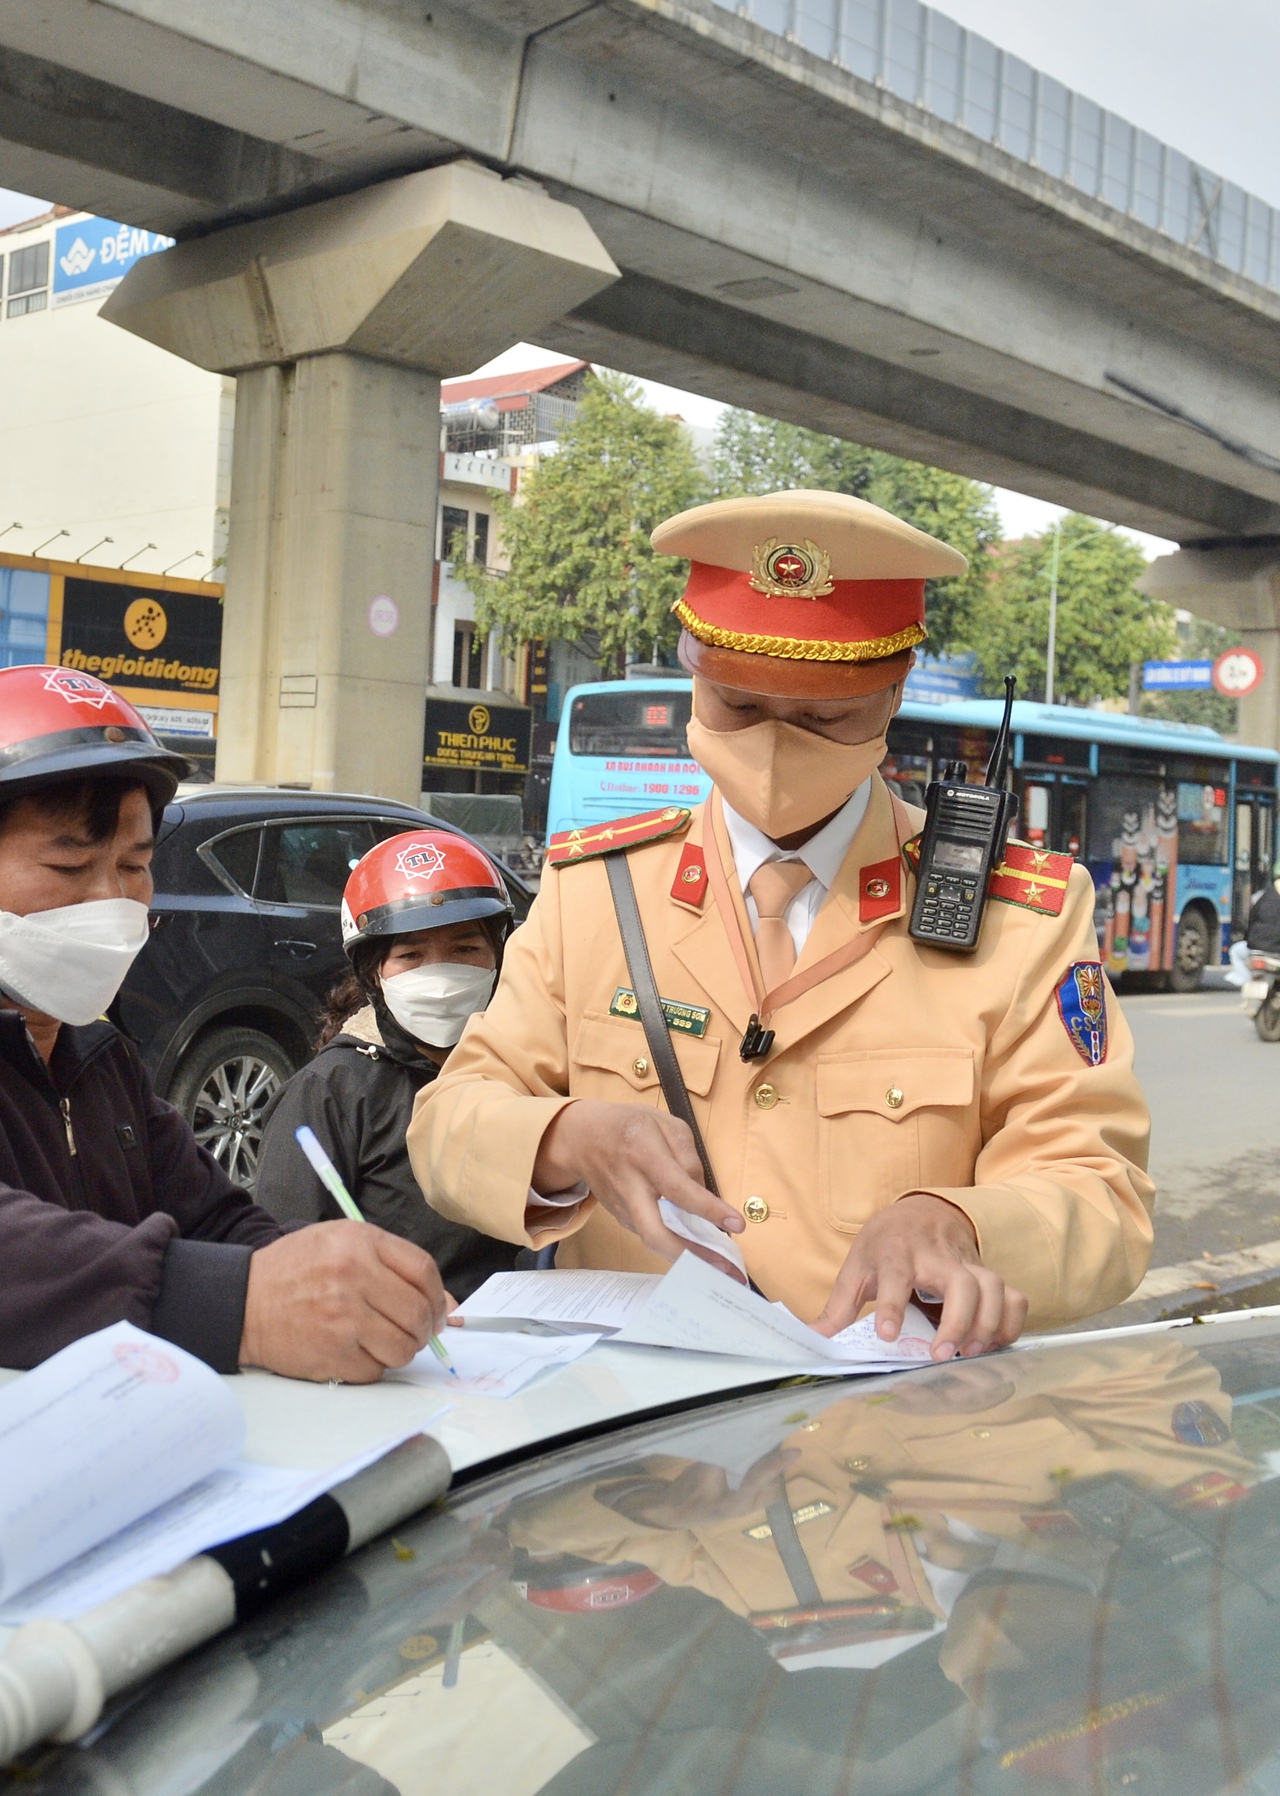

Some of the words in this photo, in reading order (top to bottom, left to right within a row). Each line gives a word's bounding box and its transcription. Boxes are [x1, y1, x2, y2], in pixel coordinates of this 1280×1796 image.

[99, 223, 149, 266] ĐỆM
[62, 648, 219, 689] thegioididong
[59, 678, 102, 692] TL
[618, 761, 633, 772] BUS
[635, 762, 666, 772] NHANH
[643, 783, 669, 794] 1900
[674, 784, 700, 795] 1296
[956, 791, 990, 801] MOTOROLA
[405, 852, 435, 869] TL
